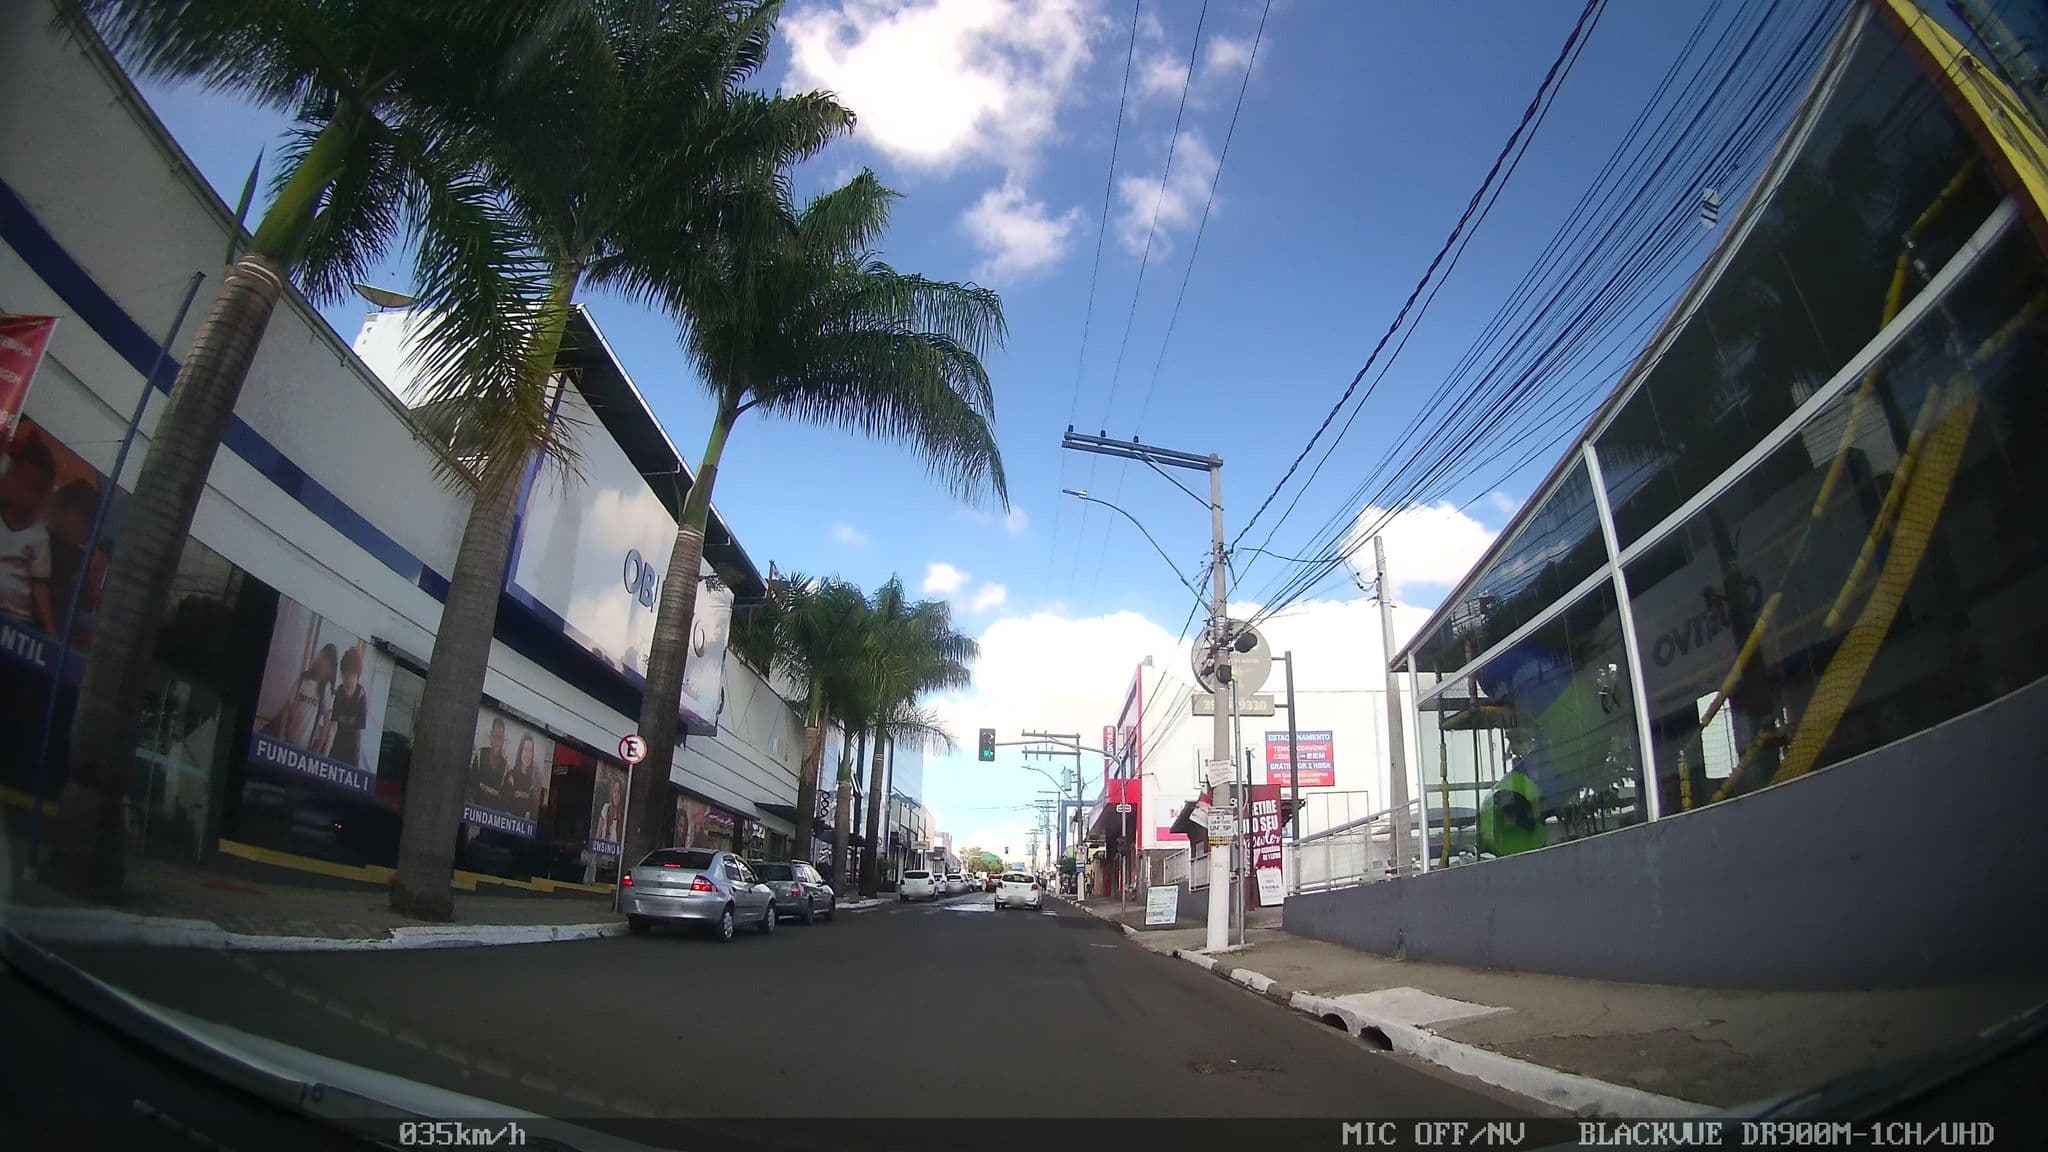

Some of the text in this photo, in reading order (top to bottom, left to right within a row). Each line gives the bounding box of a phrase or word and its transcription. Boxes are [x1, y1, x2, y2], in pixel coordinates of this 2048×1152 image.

[1268, 733, 1330, 742] ESTACNAMENTO
[257, 740, 369, 791] FUNDAMENTAL I
[463, 807, 526, 835] FUNDAMENTAL
[1260, 814, 1279, 832] SEU
